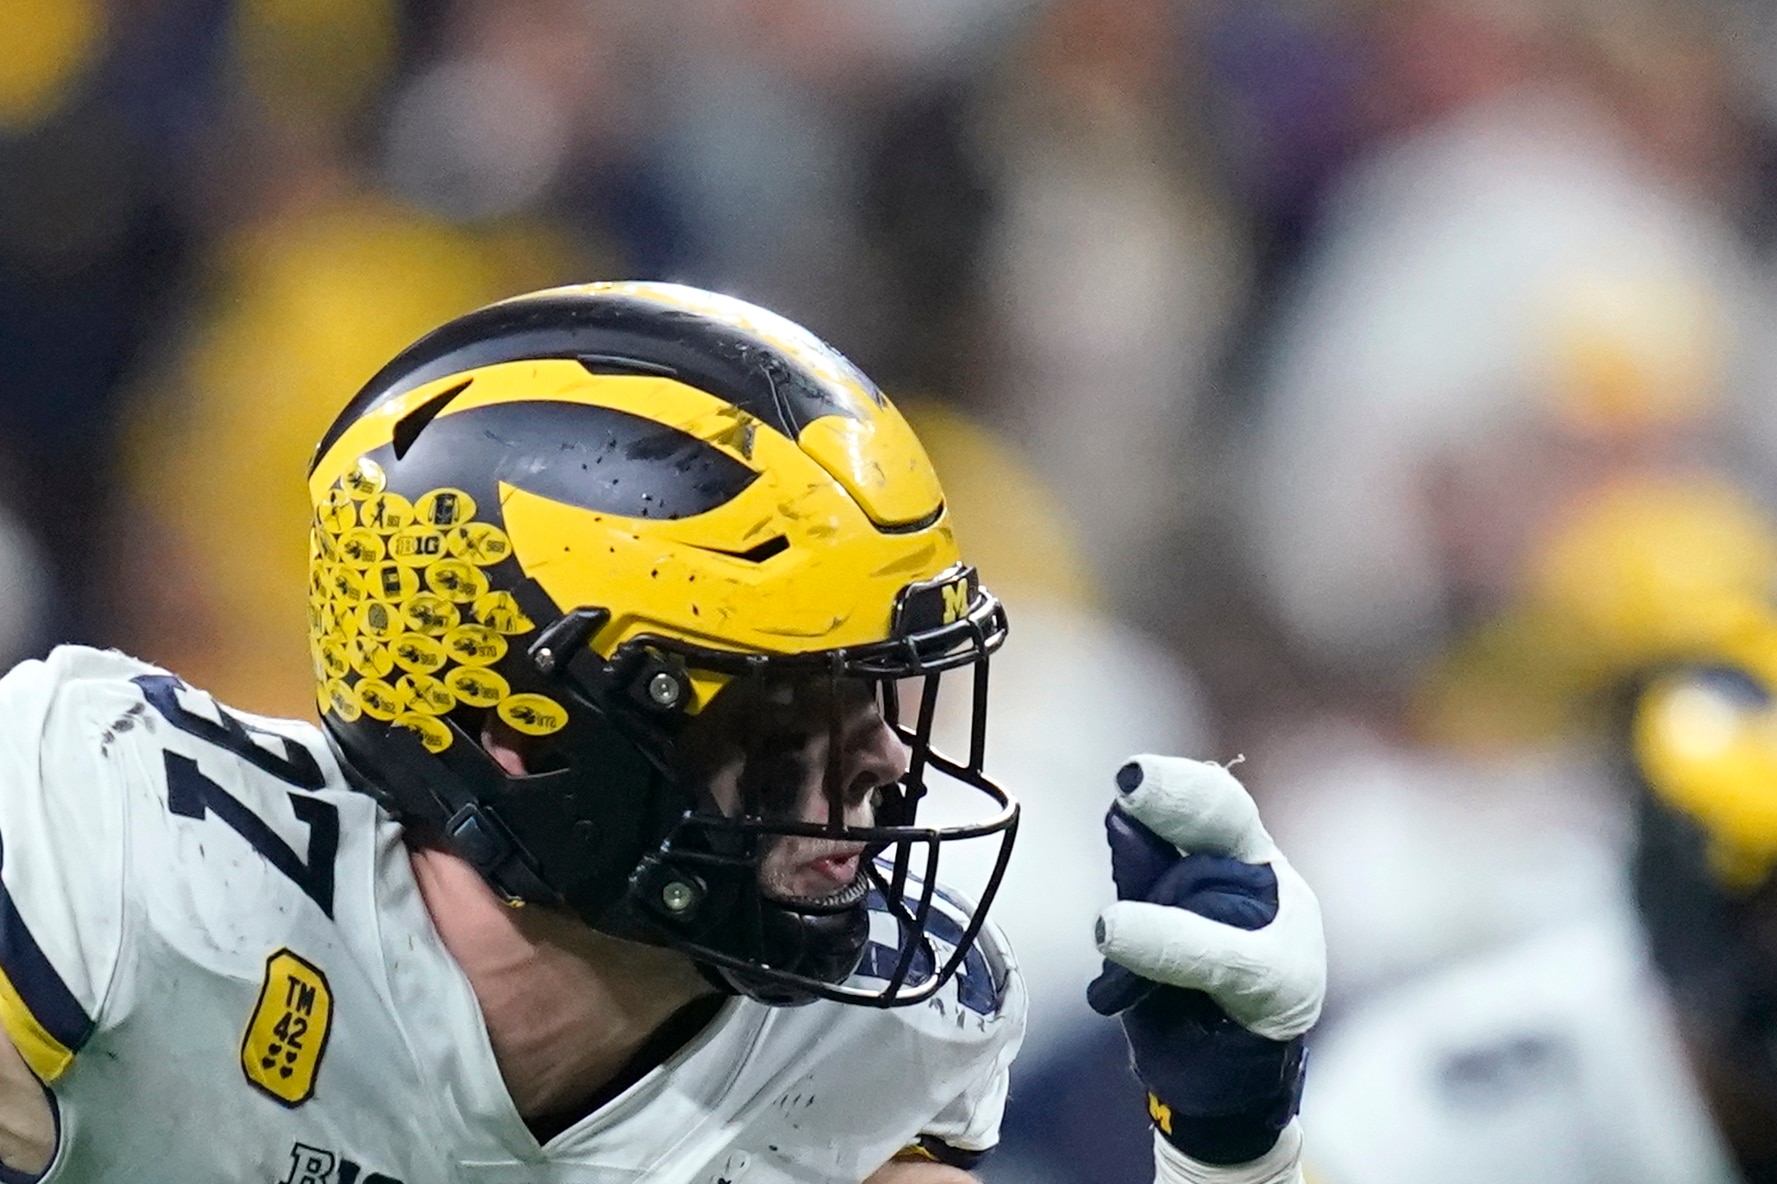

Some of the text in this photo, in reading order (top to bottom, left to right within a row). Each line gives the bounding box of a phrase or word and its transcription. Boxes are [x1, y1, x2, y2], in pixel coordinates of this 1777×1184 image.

[942, 578, 969, 624] M
[286, 975, 317, 1016] TM
[272, 1017, 309, 1050] 42
